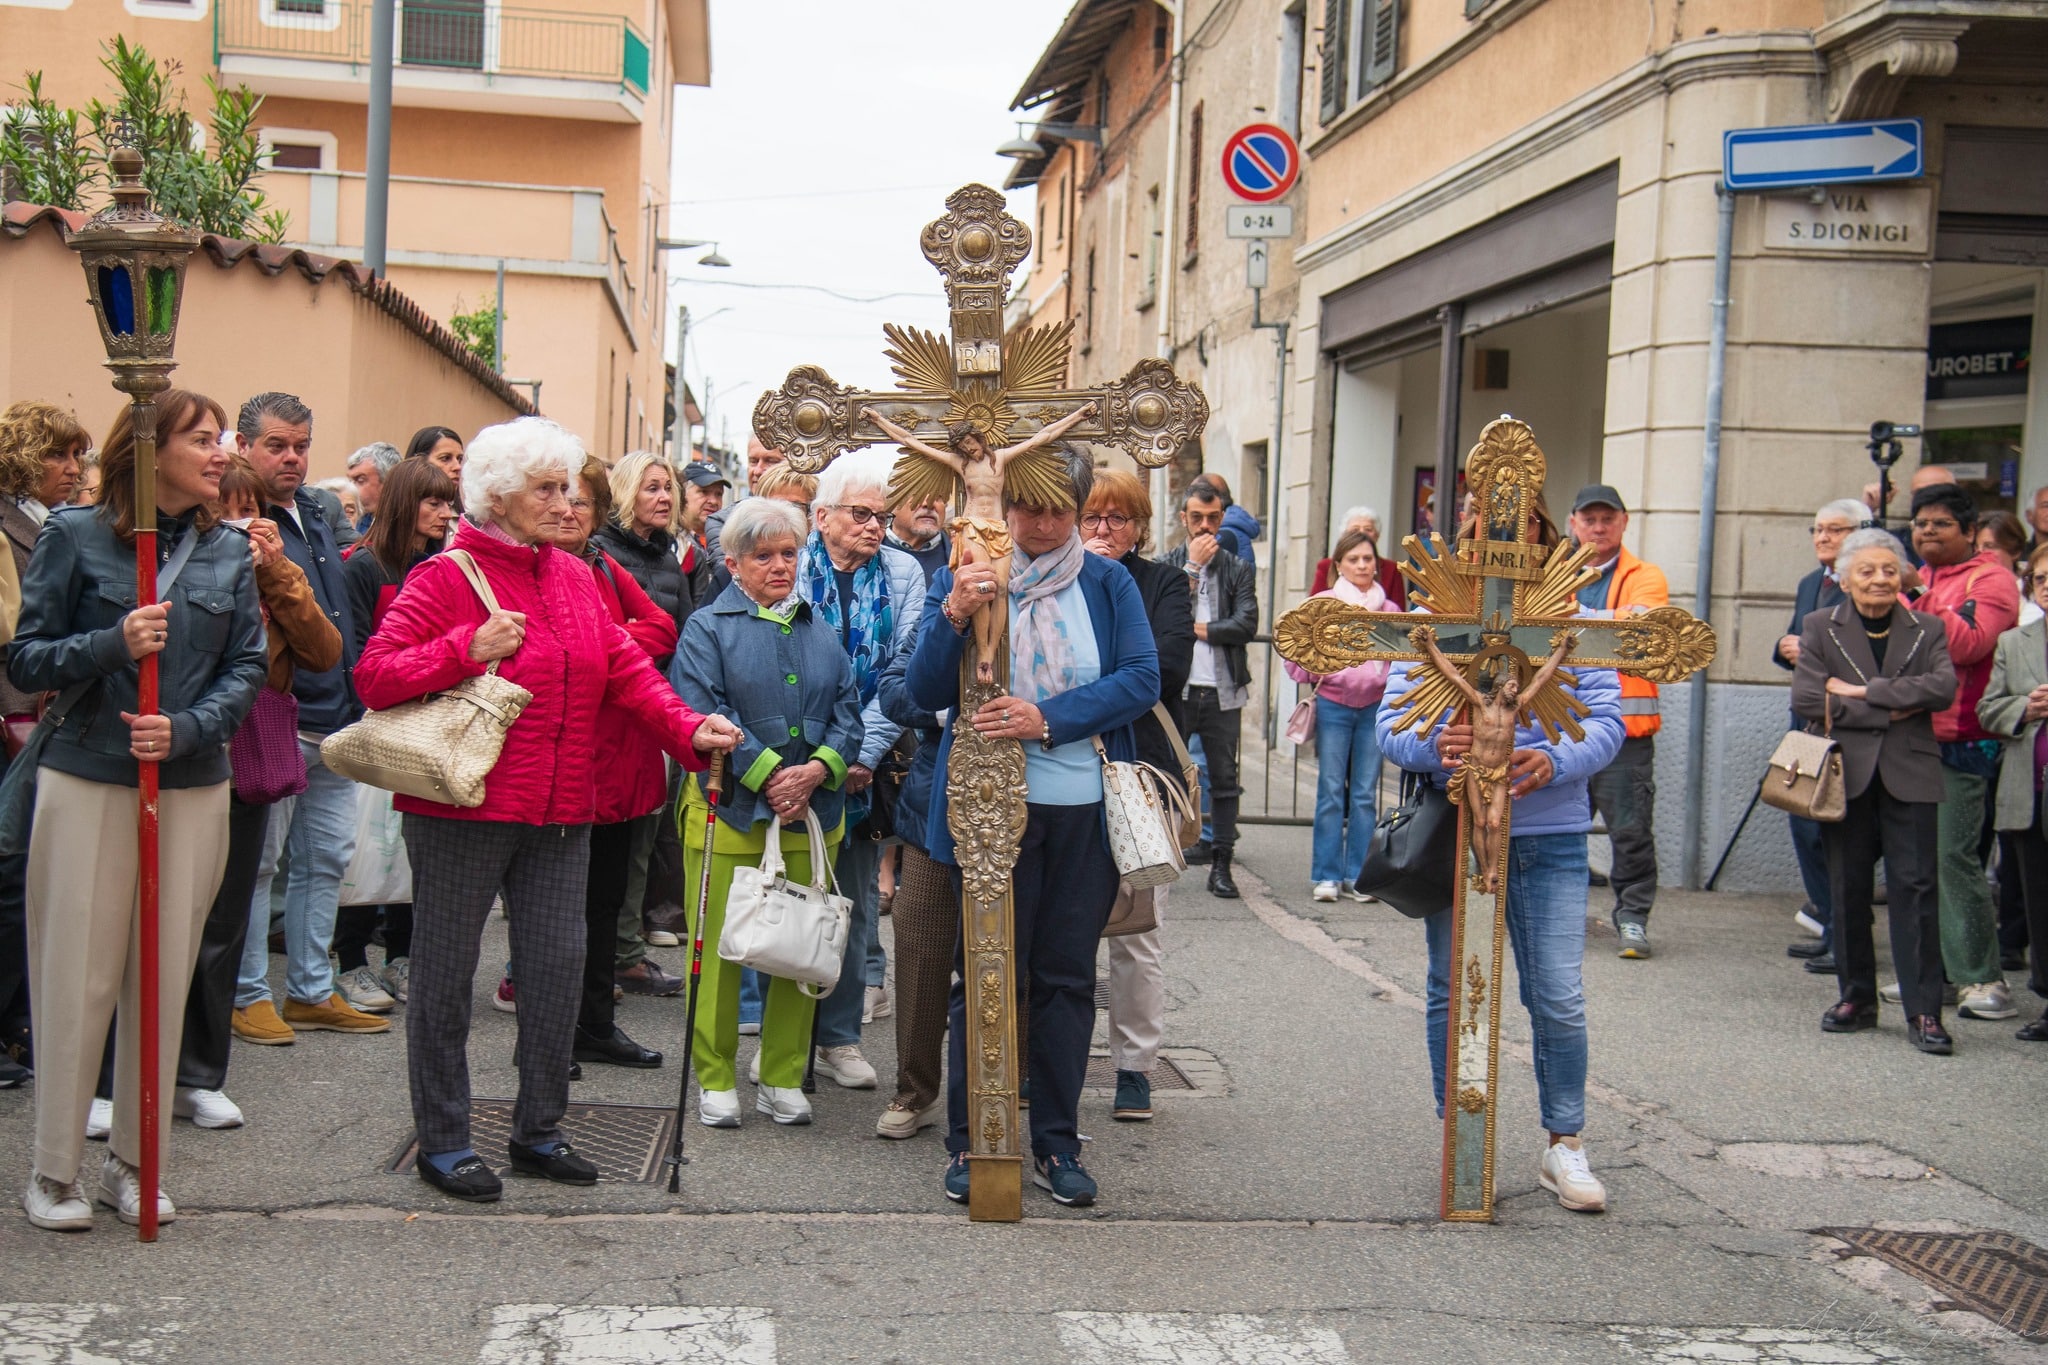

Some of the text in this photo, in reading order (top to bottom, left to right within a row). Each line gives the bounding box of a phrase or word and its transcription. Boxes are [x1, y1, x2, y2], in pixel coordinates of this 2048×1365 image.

[1830, 194, 1868, 212] VIA
[1243, 215, 1274, 229] 0-24
[1811, 222, 1909, 242] DIONIGI
